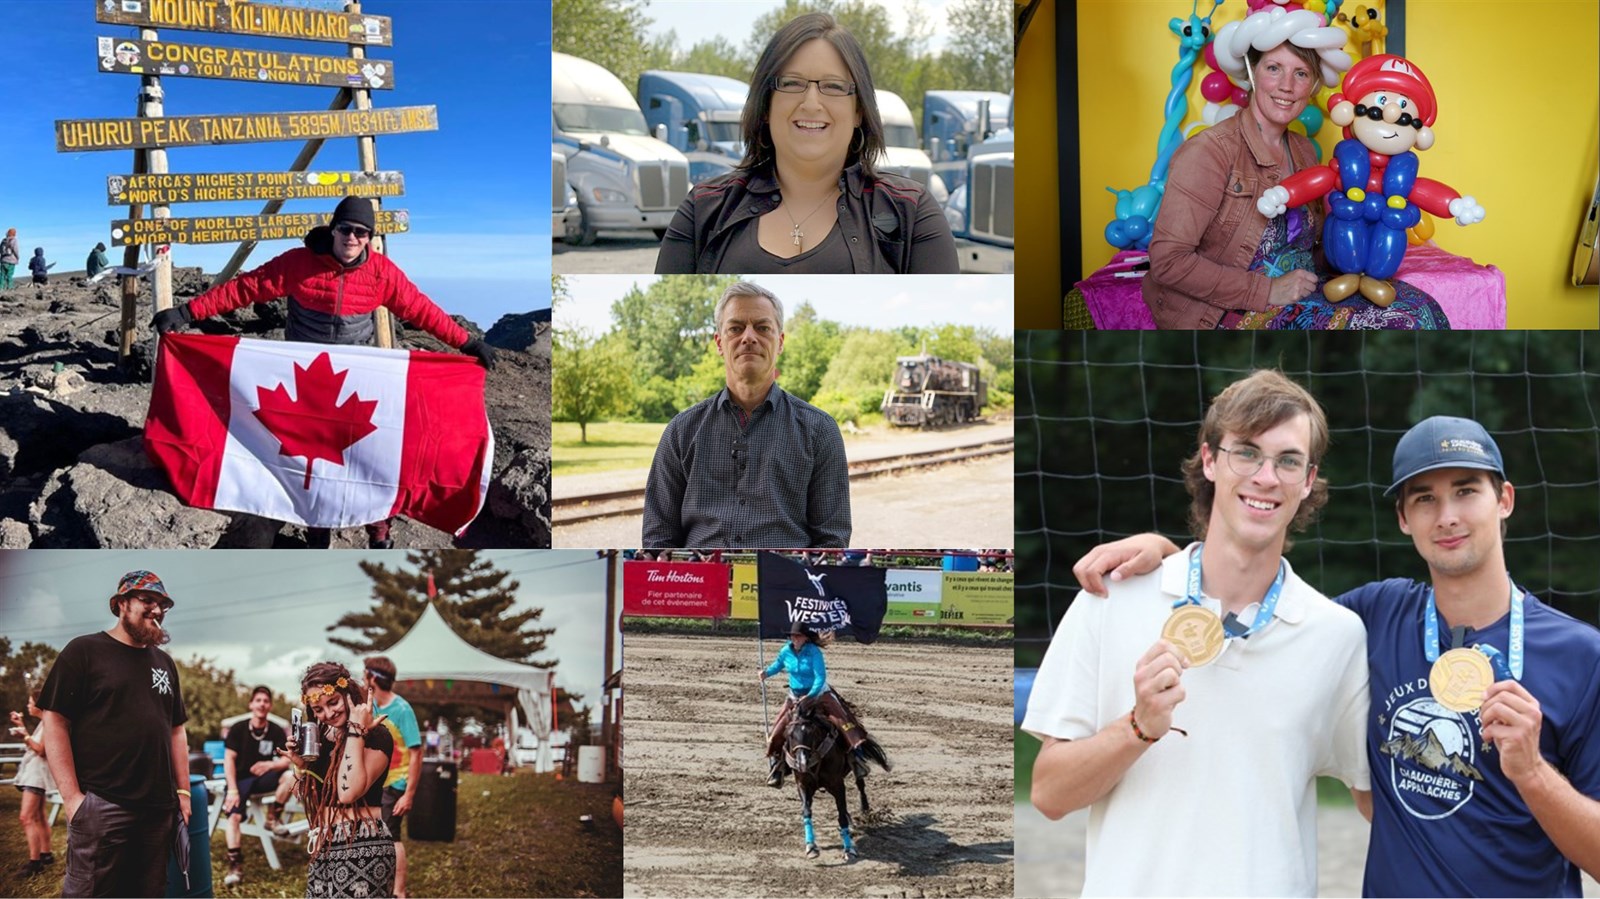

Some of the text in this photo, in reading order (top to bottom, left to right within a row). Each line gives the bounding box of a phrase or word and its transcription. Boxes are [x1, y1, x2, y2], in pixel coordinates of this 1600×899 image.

[150, 0, 348, 39] MOUNT KILIMANJARO
[147, 42, 359, 75] CONGRATULATIONS
[195, 63, 322, 84] YOU ARE NOW AT
[62, 120, 133, 147] UHURU
[129, 172, 294, 189] AFRICA'S HIGHEST POINT
[129, 188, 189, 203] WORLD'S
[194, 186, 253, 200] HIGHEST
[347, 183, 399, 196] MOUNTAIN
[134, 220, 164, 233] ONE
[170, 219, 189, 231] OF
[195, 217, 253, 229] WORLD'S
[258, 213, 317, 227] LARGEST
[134, 231, 187, 245] WORLD
[192, 229, 257, 243] HERITAGE
[261, 226, 284, 238] AND
[374, 222, 401, 234] RICA
[646, 569, 705, 584] Tim Hortons
[886, 581, 922, 592] vantis
[641, 598, 652, 606] de
[647, 590, 703, 600] Fier partenaire
[1511, 624, 1520, 651] OASIS
[1384, 678, 1428, 712] JEUX D
[1398, 779, 1462, 801] APPALACHES
